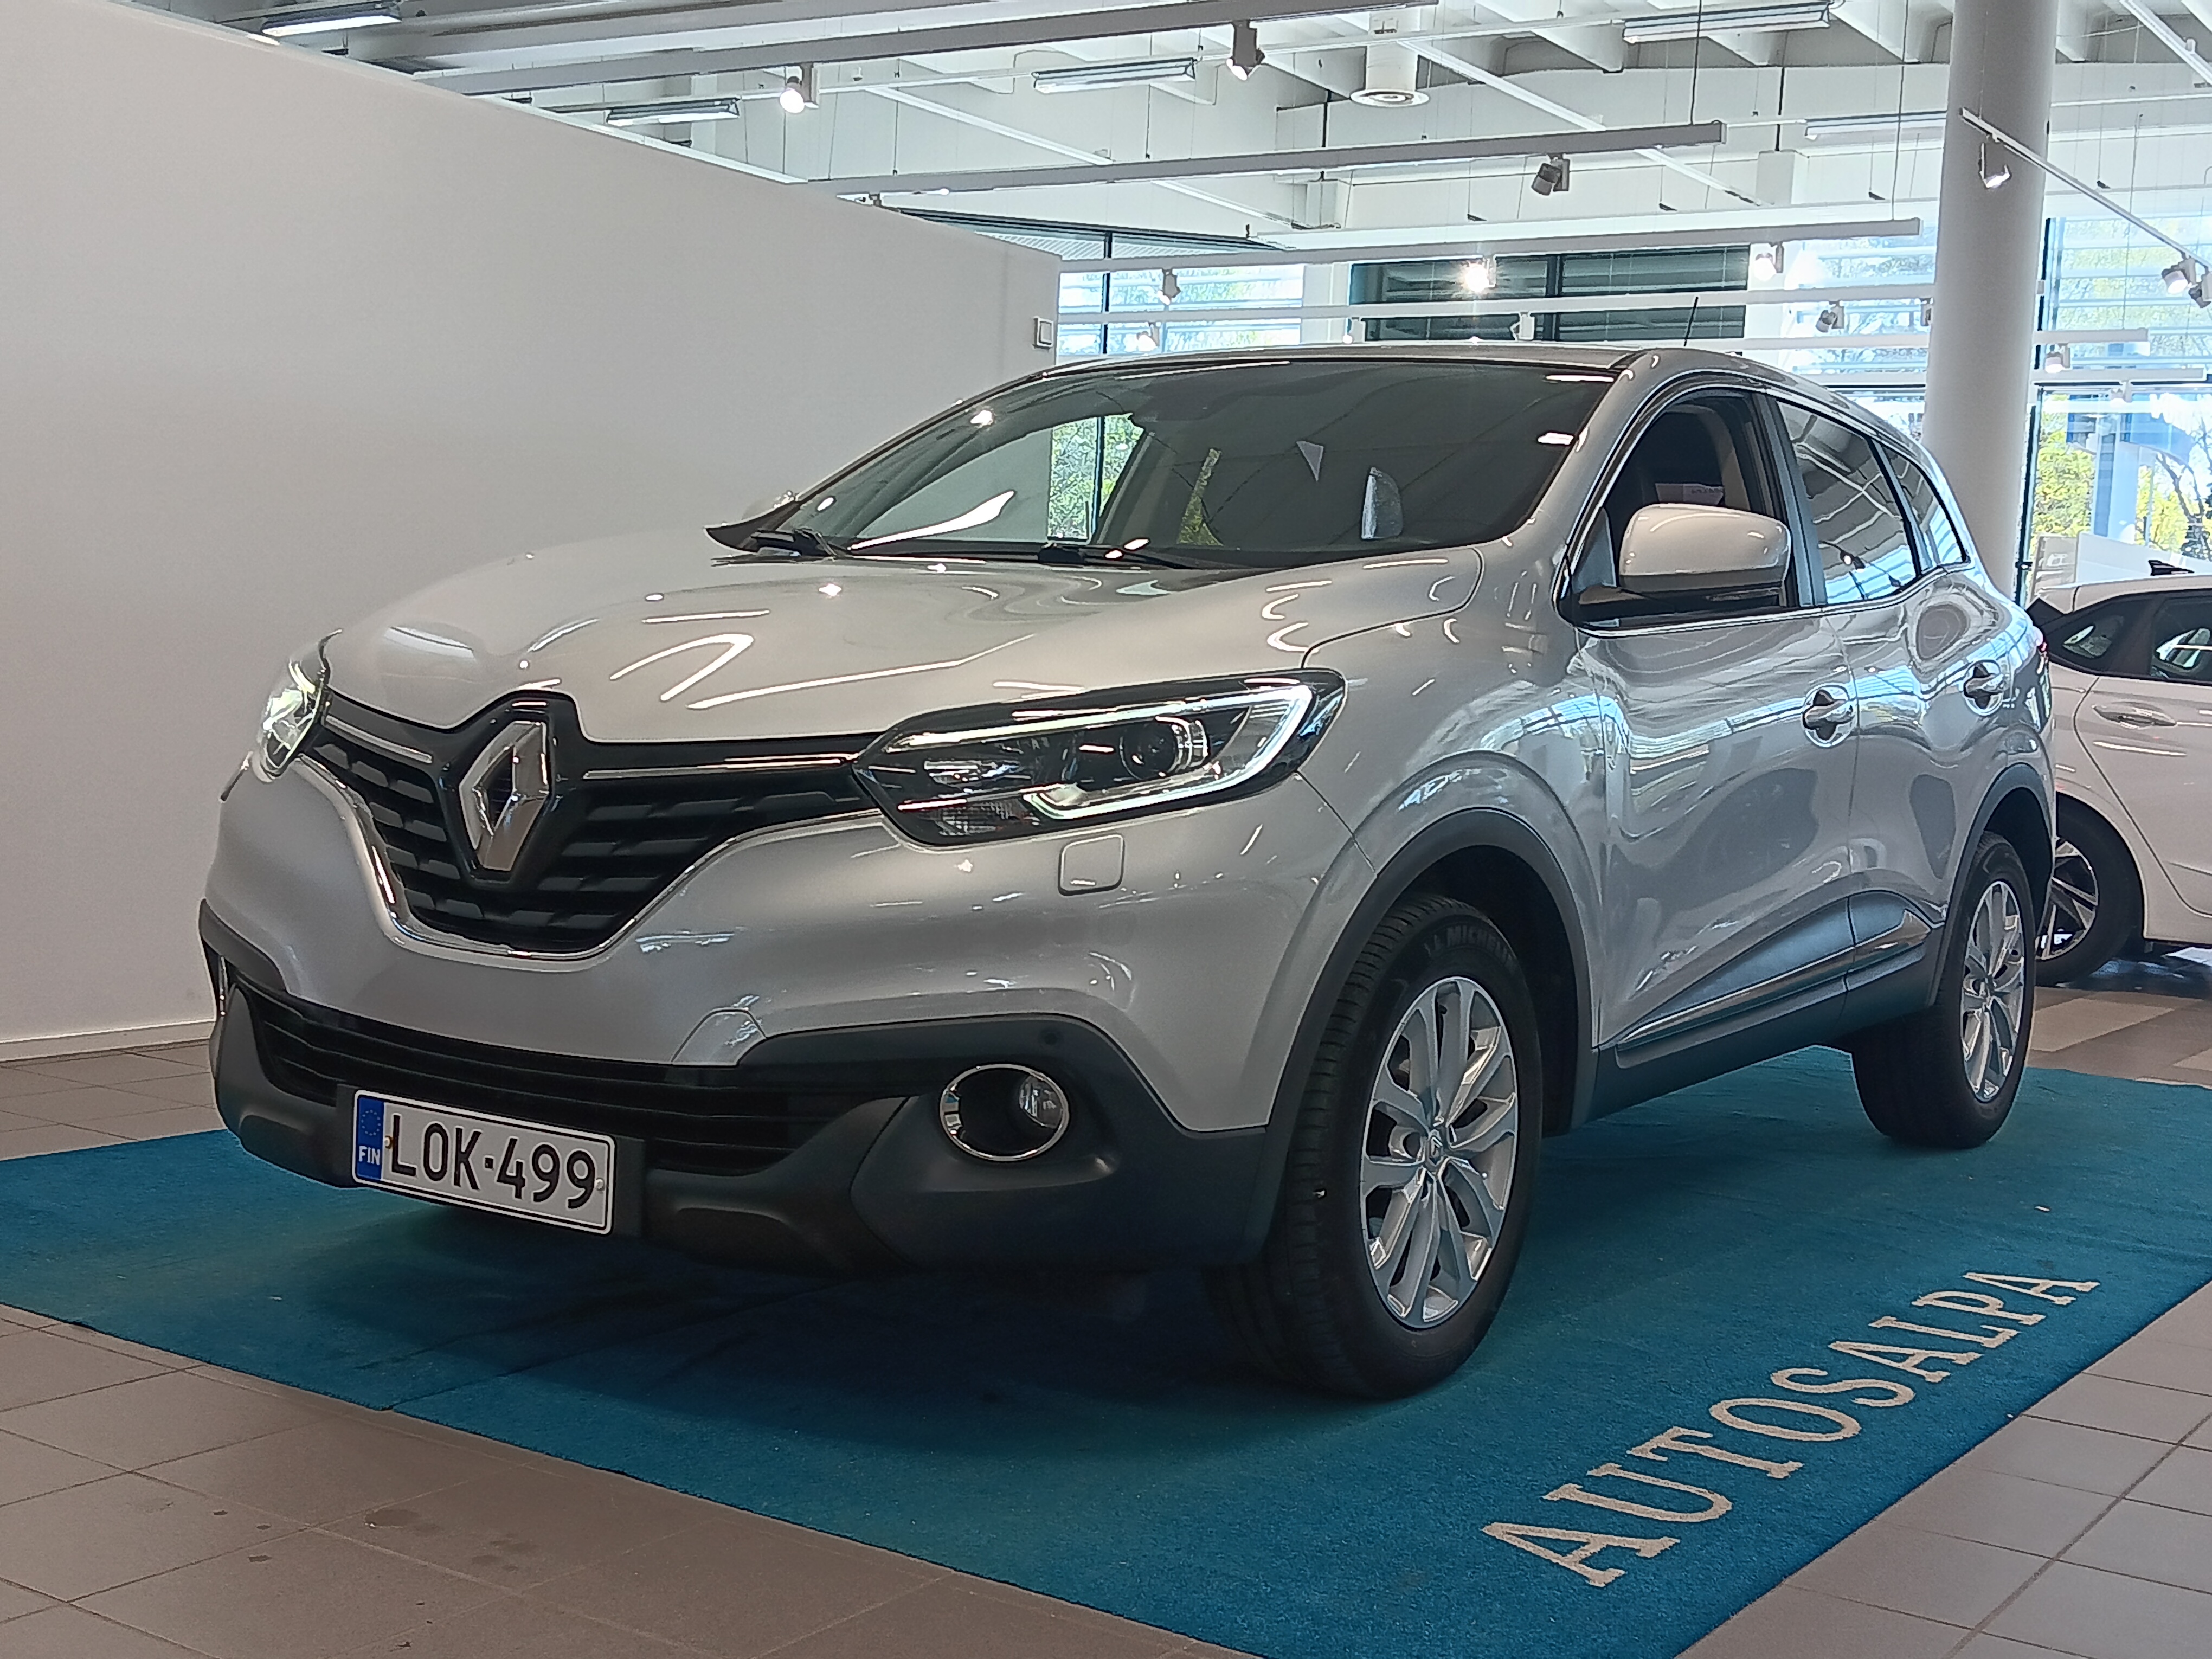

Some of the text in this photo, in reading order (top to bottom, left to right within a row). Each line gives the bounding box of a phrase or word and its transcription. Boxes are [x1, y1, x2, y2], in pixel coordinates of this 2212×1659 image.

[358, 1145, 381, 1165] FIN
[390, 1114, 596, 1209] LOK-499
[1482, 1272, 2101, 1587] AUTOSALPA
